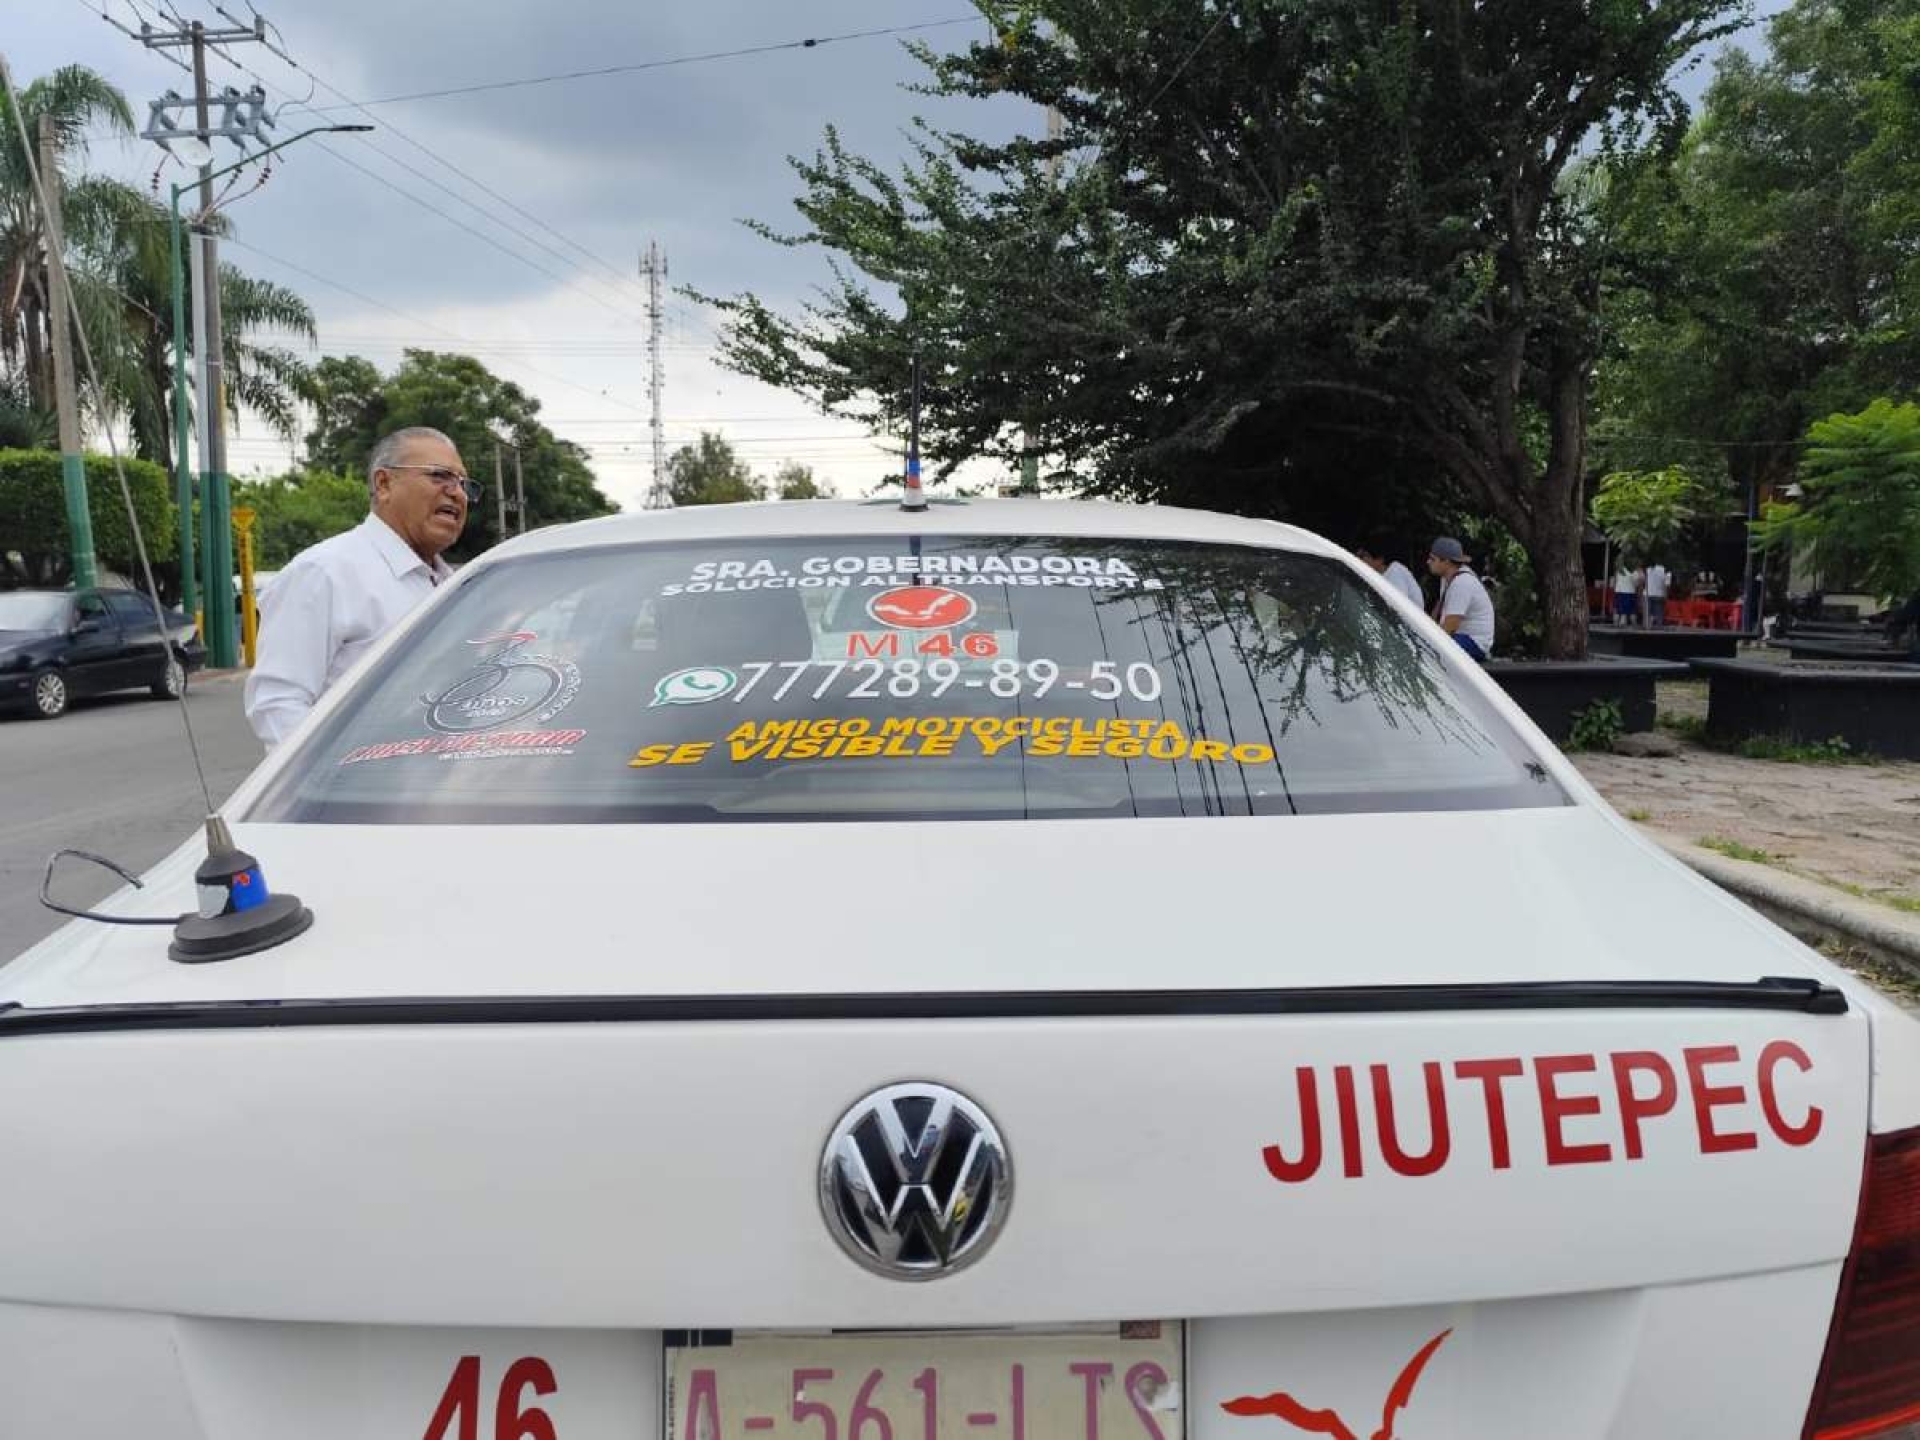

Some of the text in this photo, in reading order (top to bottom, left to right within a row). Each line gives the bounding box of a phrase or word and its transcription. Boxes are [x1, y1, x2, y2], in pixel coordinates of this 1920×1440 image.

[690, 555, 1136, 582] SRA. GOBERNADORA
[661, 573, 1165, 596] SOLUCION AL TRANSPORTE
[847, 631, 1000, 659] M 46
[732, 658, 1162, 702] 777289-89-50
[725, 716, 1188, 742] AMIGO MOTOCICLISTA
[628, 735, 1275, 768] SE VISIBLE Y SEGURO
[1262, 1040, 1823, 1183] JIUTEPEC
